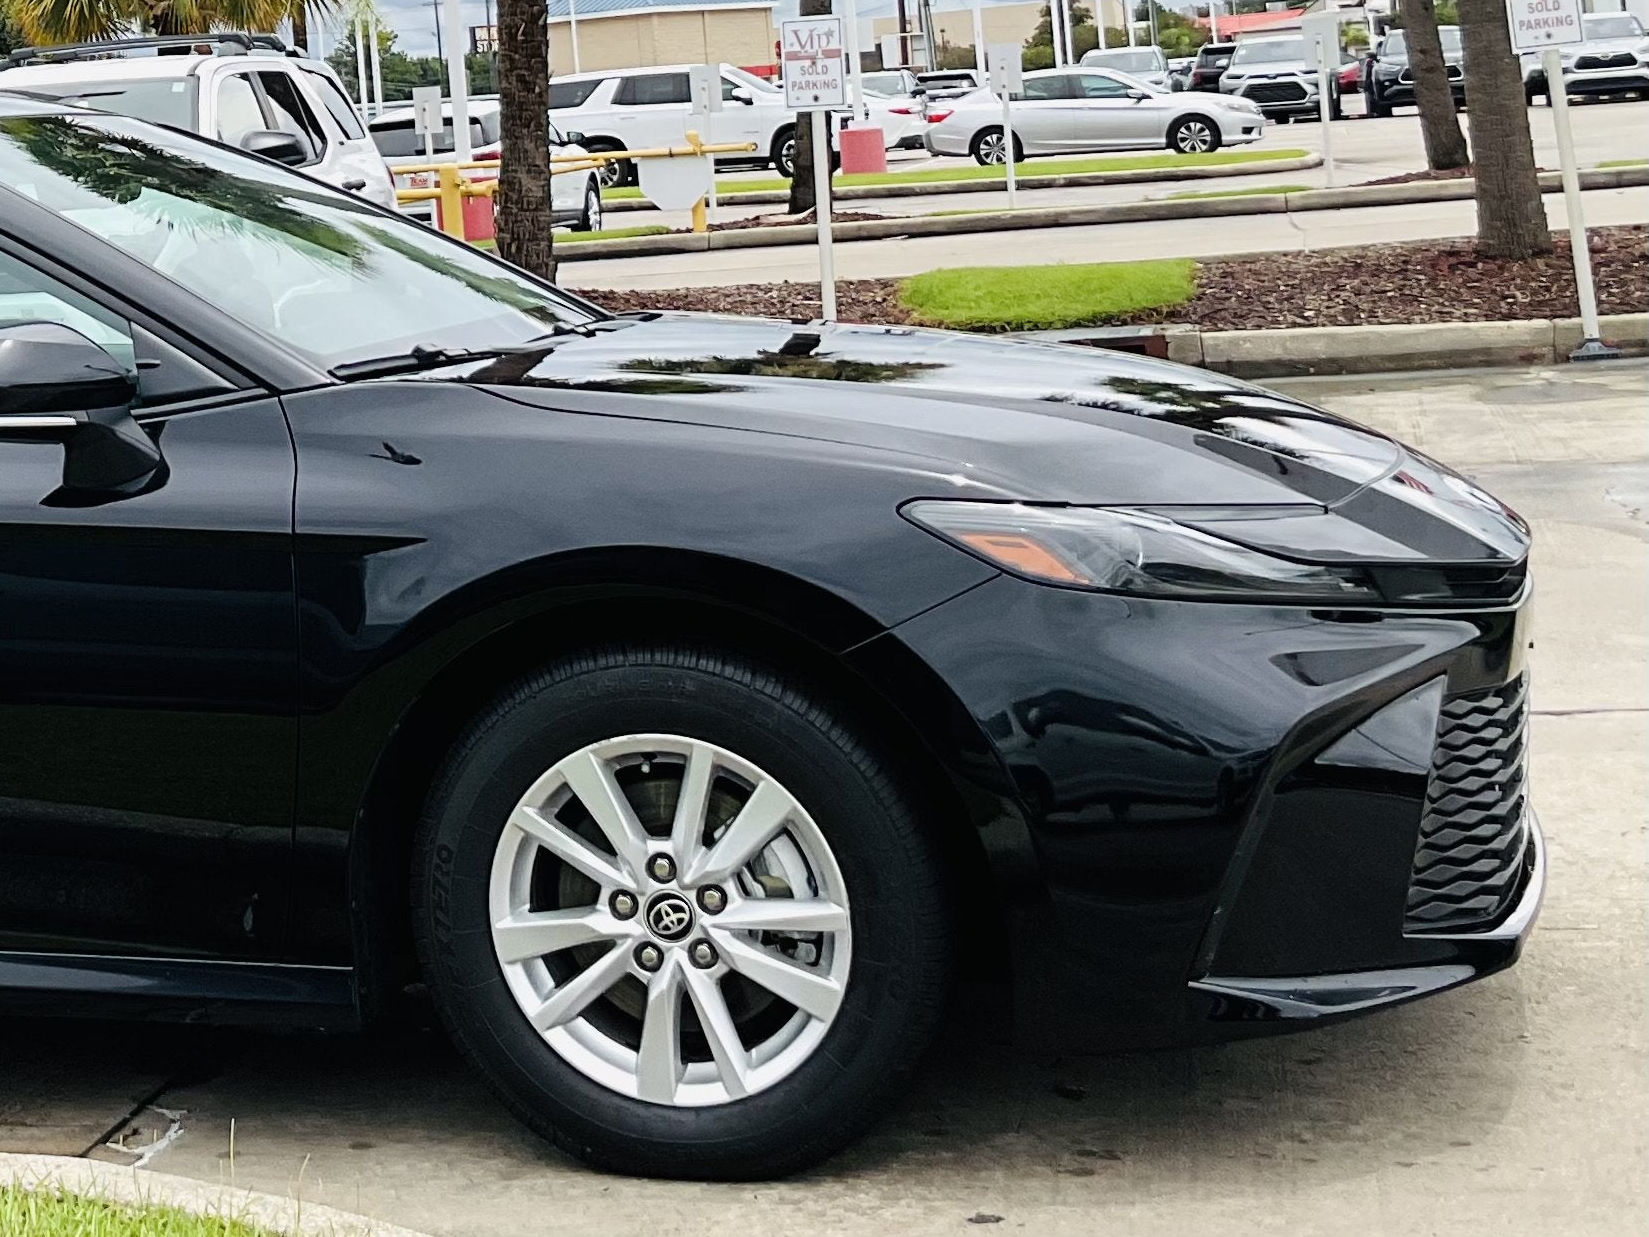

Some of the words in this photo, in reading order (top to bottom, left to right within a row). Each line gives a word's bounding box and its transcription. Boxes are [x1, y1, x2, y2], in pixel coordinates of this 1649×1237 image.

[1527, 0, 1561, 14] SOLD
[1518, 15, 1574, 31] PARKING
[800, 64, 829, 76] SOLD
[791, 78, 838, 92] PARKING
